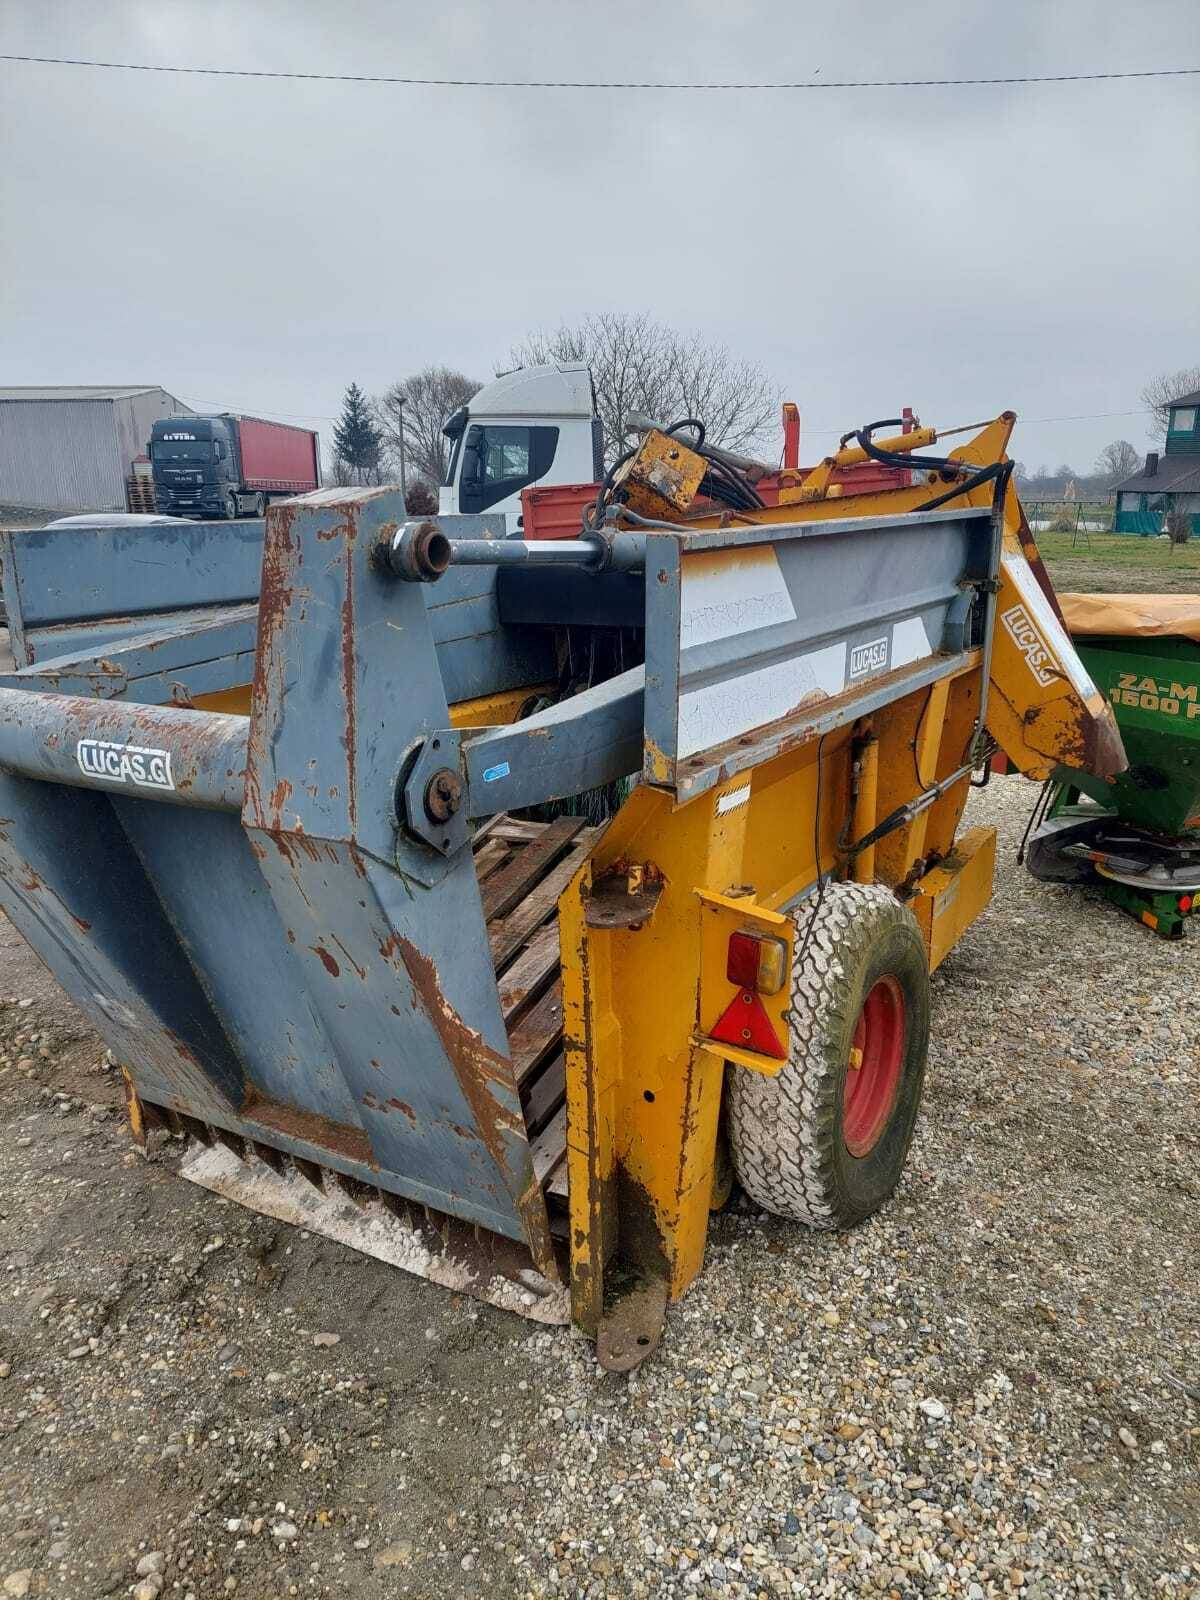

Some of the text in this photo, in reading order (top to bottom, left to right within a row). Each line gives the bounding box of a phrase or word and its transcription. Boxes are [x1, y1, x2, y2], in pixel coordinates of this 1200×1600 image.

[852, 642, 887, 673] LUCAS.G
[1119, 673, 1198, 702] ZA-M
[81, 745, 168, 784] LUCAS.G
